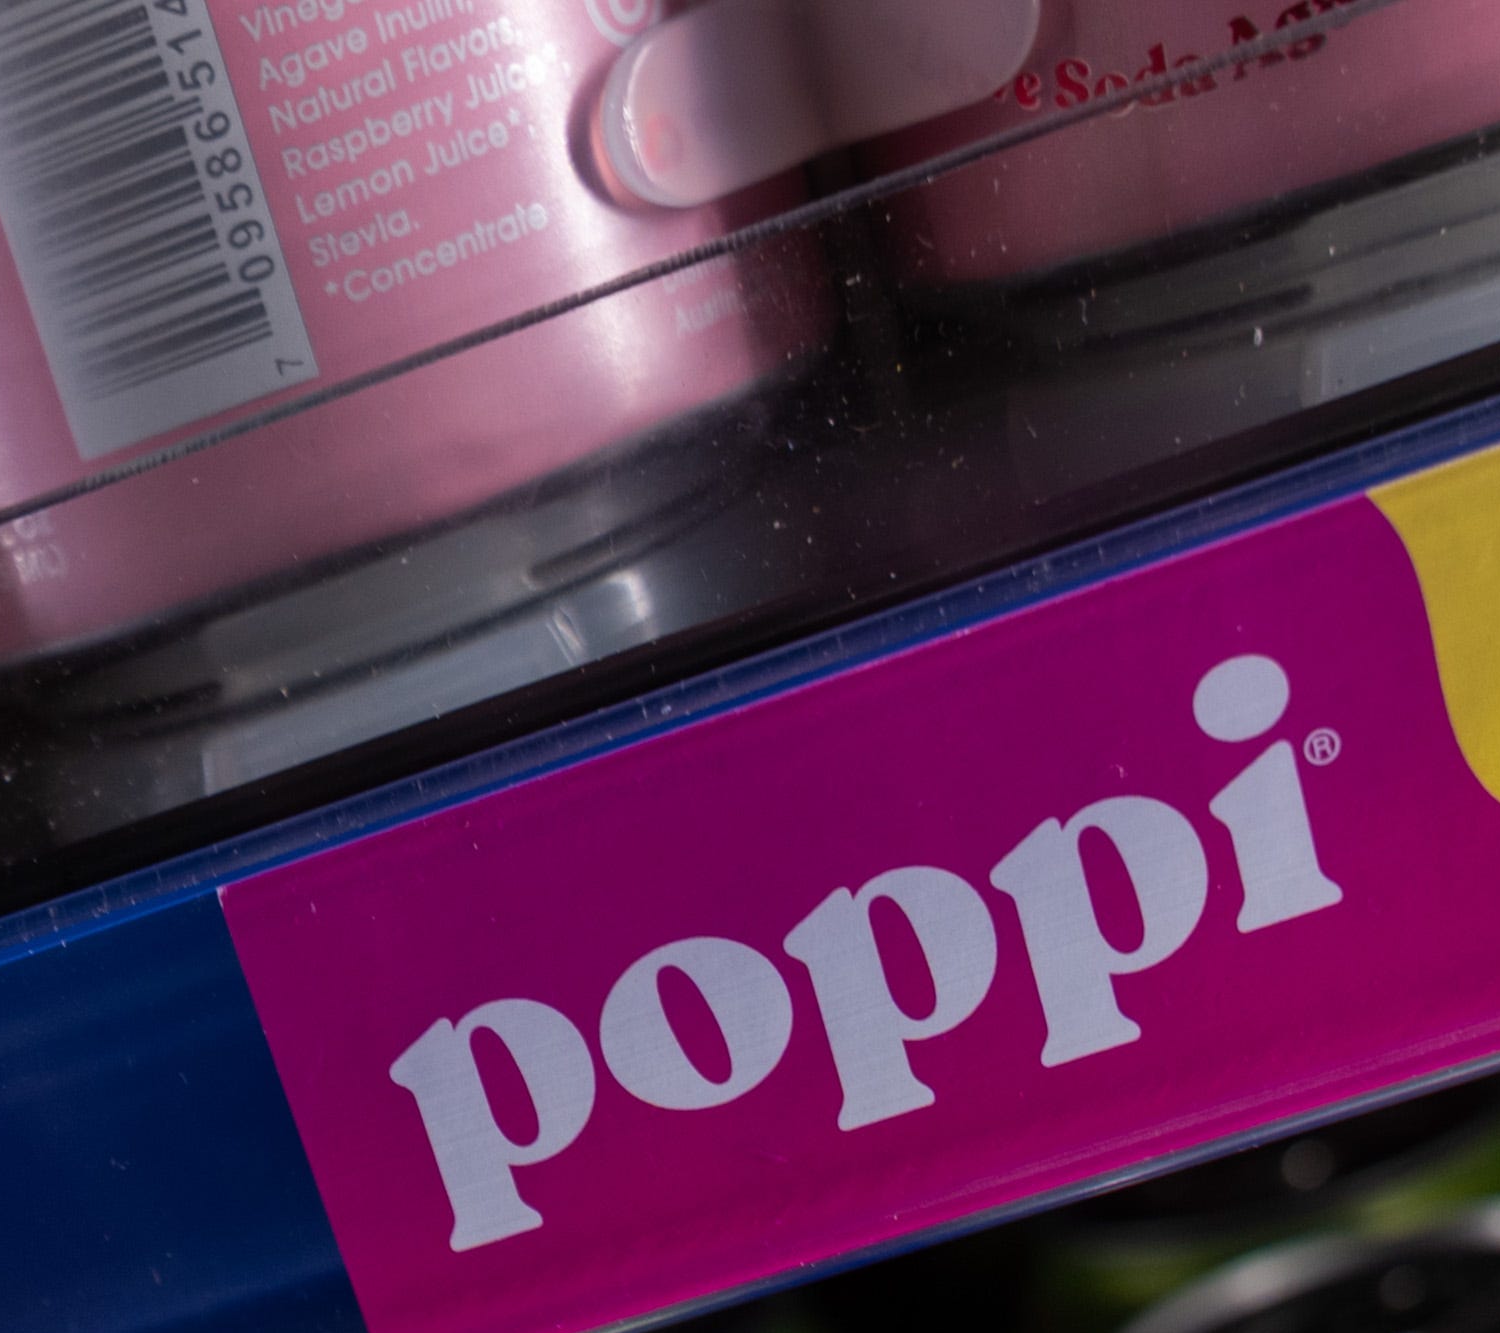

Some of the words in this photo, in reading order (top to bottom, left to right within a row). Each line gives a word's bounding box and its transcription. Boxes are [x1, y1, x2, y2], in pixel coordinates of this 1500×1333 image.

[256, 25, 369, 91] Agave
[267, 58, 397, 136] Natural
[401, 15, 524, 80] Flavors,
[280, 90, 454, 180] Raspberry
[193, 110, 276, 284] 09586
[295, 157, 416, 226] Lemon
[307, 205, 422, 269] Stevia.
